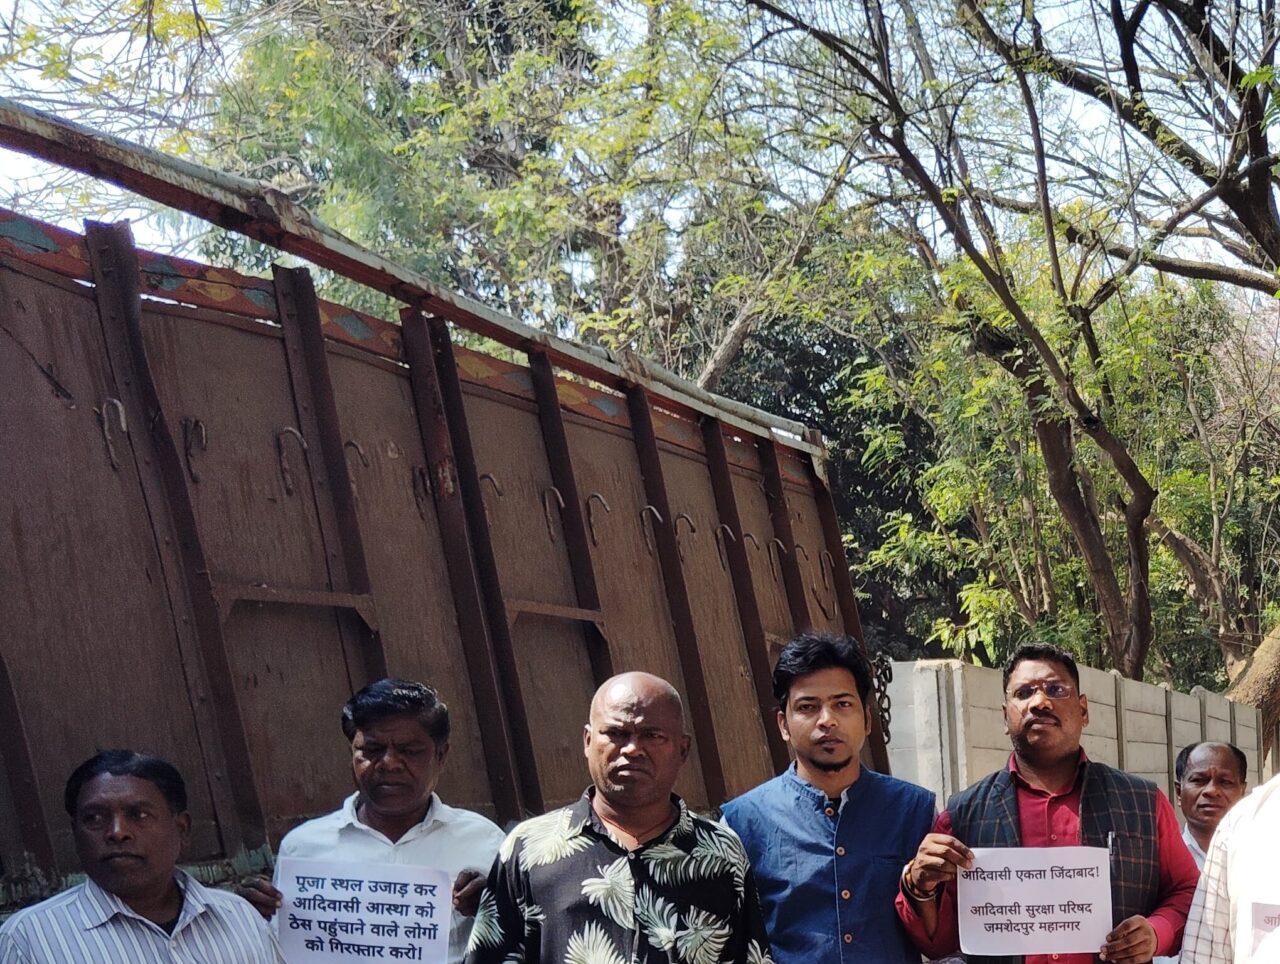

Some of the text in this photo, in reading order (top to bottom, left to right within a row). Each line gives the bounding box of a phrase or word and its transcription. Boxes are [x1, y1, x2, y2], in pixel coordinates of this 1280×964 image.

[962, 866, 1100, 882] आदिवासी एकता जिंदाबाद!
[295, 875, 437, 899] पूजा स्थल उजाड़ कर
[293, 896, 436, 918] आदिवासी आस्था को
[970, 901, 1093, 918] आदिवासी सुरक्षा परिषद
[288, 914, 438, 940] ठेस पहुंचाने वाले लोगों
[984, 919, 1080, 935] जमशेदपुर महानगर
[304, 936, 324, 952] को
